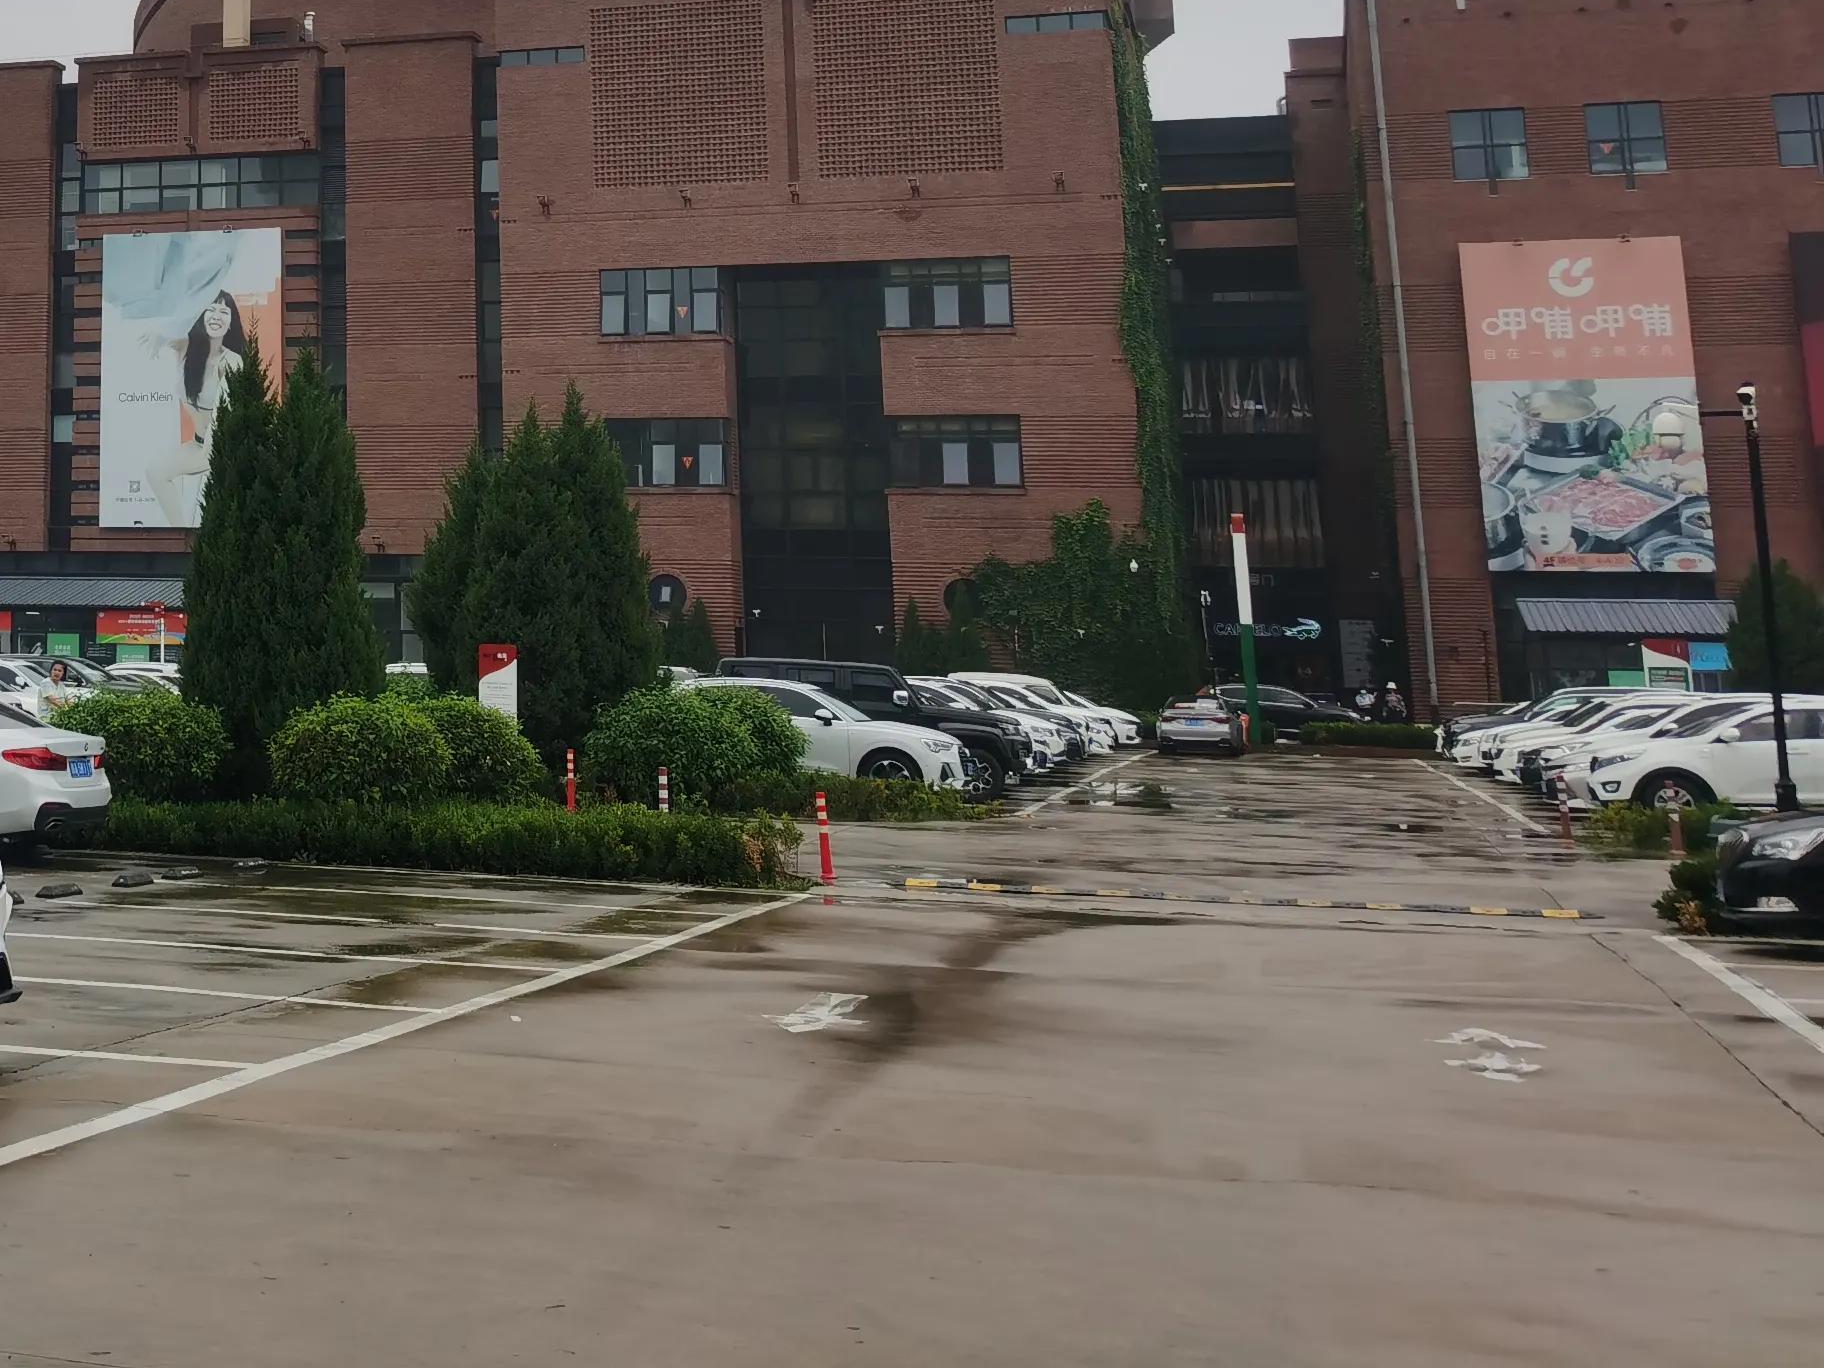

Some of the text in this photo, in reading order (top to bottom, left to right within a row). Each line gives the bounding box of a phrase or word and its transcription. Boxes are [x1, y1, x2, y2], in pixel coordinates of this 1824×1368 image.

[1481, 303, 1673, 340] 呷哺呷哺
[118, 392, 174, 403] Calvin Klein
